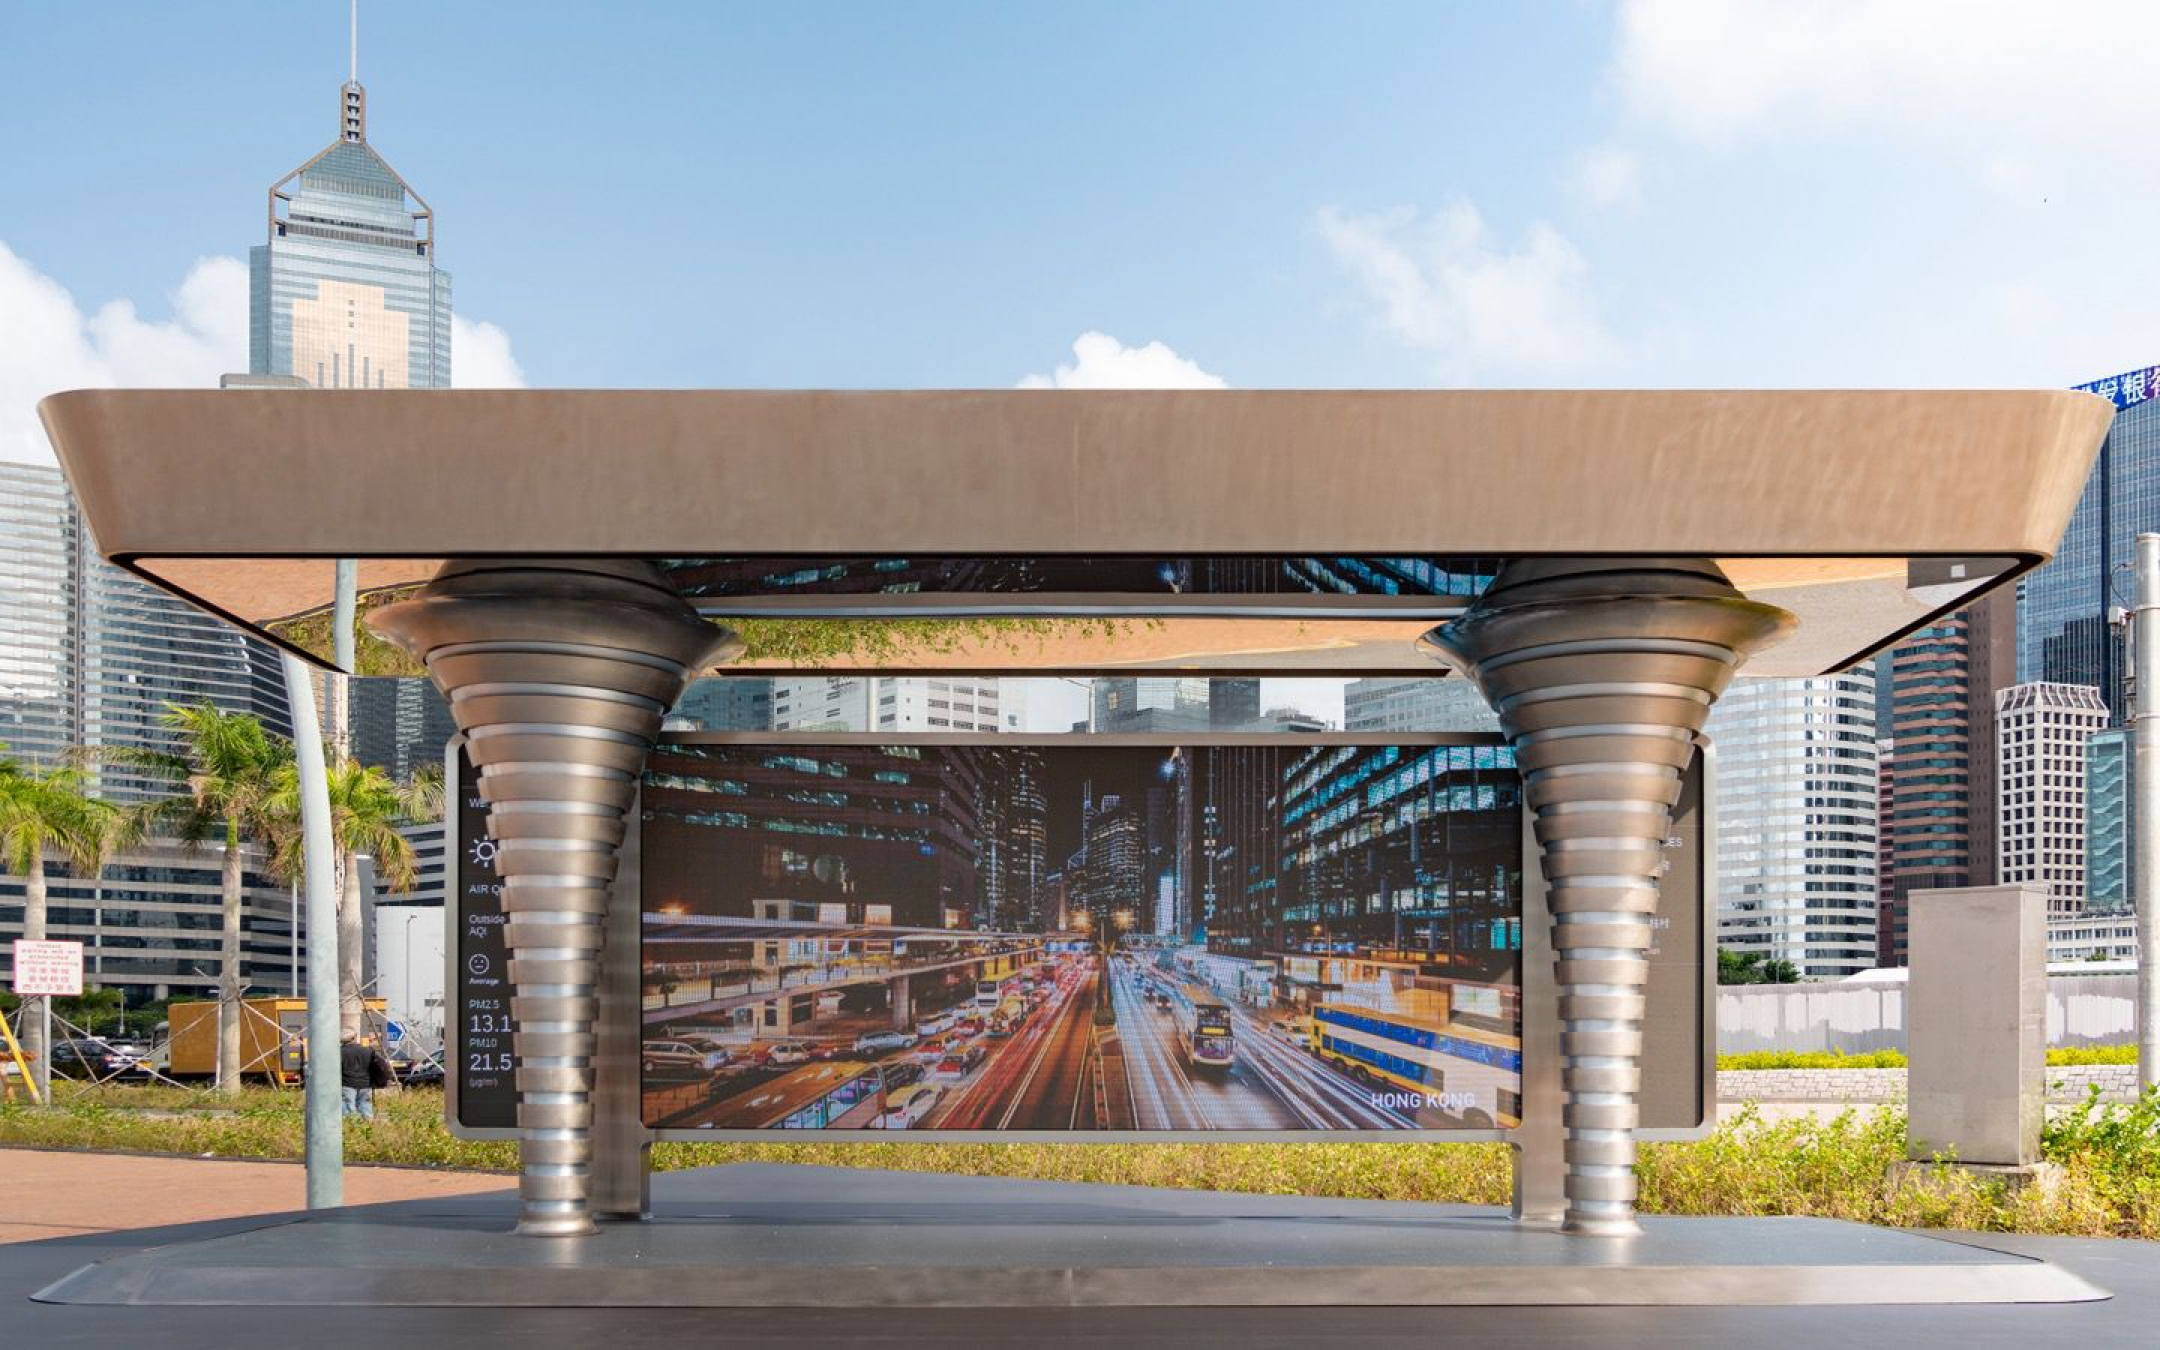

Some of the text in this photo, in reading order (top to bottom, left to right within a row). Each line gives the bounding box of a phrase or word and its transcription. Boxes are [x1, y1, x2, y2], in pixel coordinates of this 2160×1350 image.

[469, 884, 504, 896] AIR Q
[469, 914, 506, 925] Outside
[469, 999, 500, 1009] PM2.5
[470, 1014, 512, 1033] 13.1
[469, 1037, 498, 1048] PM10
[470, 1053, 513, 1071] 21.5
[1371, 1091, 1476, 1109] HONG KONG
